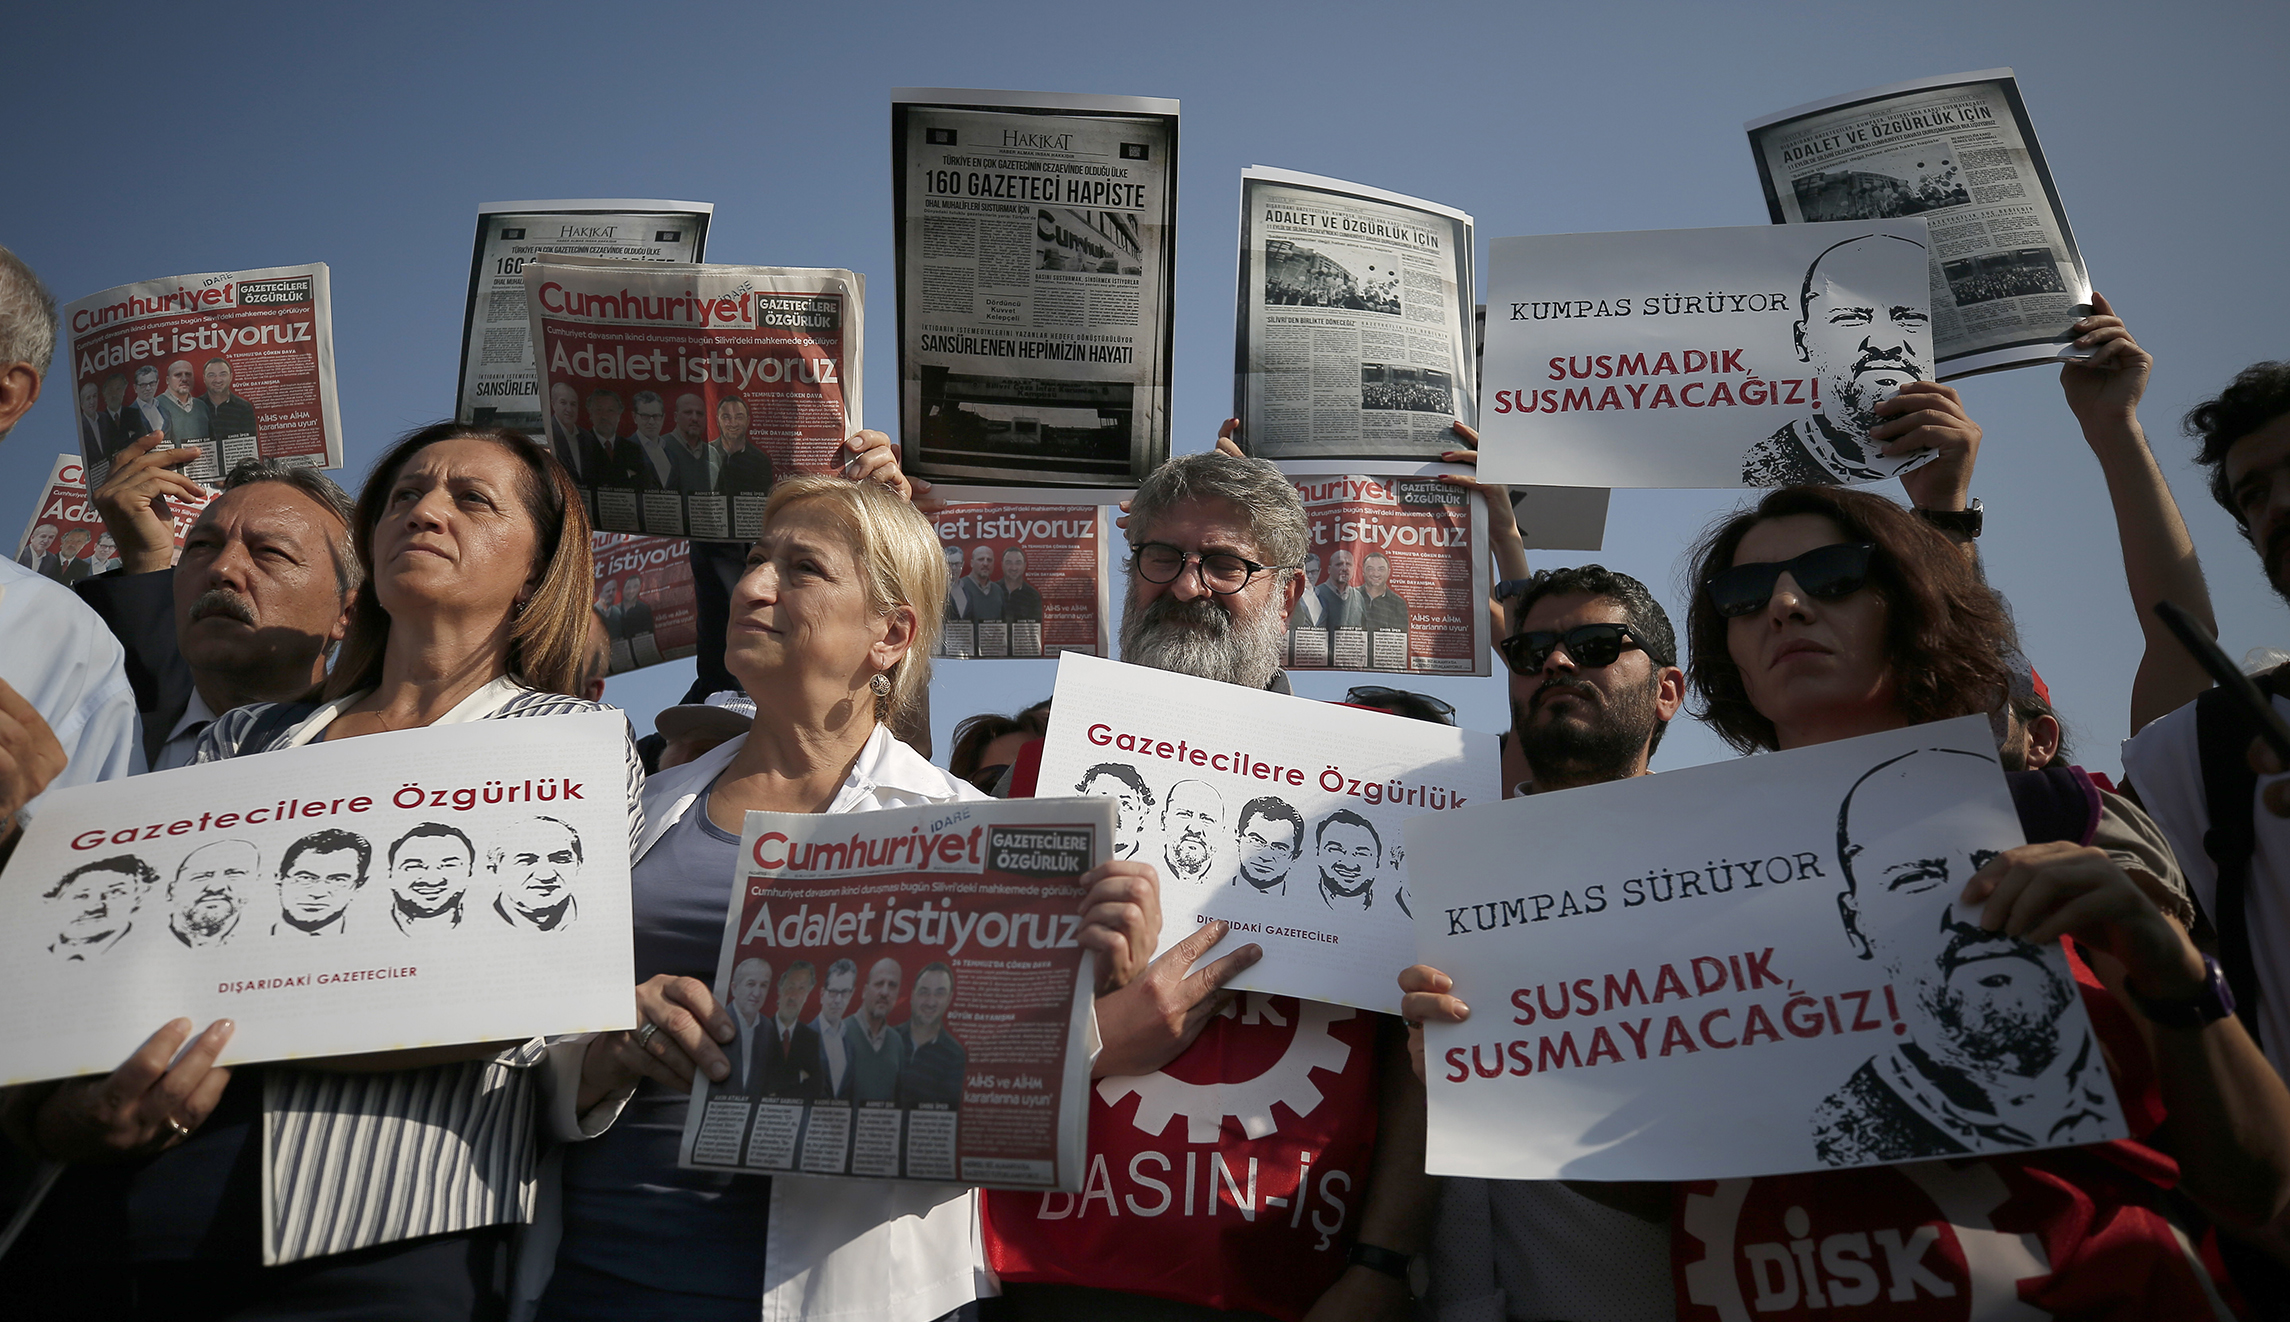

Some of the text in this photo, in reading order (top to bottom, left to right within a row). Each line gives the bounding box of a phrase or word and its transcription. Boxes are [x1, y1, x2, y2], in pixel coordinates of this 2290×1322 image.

[1002, 129, 1073, 150] HAKİKAT
[1784, 135, 1844, 164] ADALET
[1846, 129, 1867, 144] VE
[1872, 111, 1957, 138] ÖZGÜRLÜK
[1958, 104, 1992, 122] İÇİN
[942, 155, 1128, 178] TÜRKİYE EN ÇOK GAZETECİNİN CEZAEVİNDE OLDUĞU ÜLKE
[926, 169, 1146, 208] 160 GAZETECİ HAPİSTE
[942, 200, 980, 212] MUHALİFLERİ
[981, 202, 1016, 214] SUSTURMAK
[1017, 204, 1030, 215] İÇİN
[1266, 210, 1440, 248] ADALET VE ÖZGÜRLÜK İÇİN
[496, 258, 522, 274] 160
[240, 282, 308, 293] GAZETECİLERE
[245, 292, 304, 304] ÖZGÜRLÜK
[72, 282, 234, 334] Cumhuriyet
[538, 281, 752, 328] Cumhuriyet
[759, 298, 837, 313] GAZETECİLERE
[986, 298, 1022, 308] Dördüncü
[990, 306, 1016, 314] Kuvvet
[1510, 290, 1790, 322] KUMPAS SÜRÜYOR
[765, 312, 830, 328] ÖZGÜRLÜK
[986, 314, 1020, 322] Kelepçeli
[78, 321, 312, 380] Adalet istiyoruz
[546, 326, 838, 348] Cumhuriyet davasının ikinci duruşması bugün Silivri'deki mahkemede görülüyor
[921, 333, 1133, 364] SANSÜRLENEN HEPİMİZİN HAYATI
[550, 340, 668, 382] Adalet
[678, 346, 838, 391] istiyoruz
[1548, 348, 1754, 382] SUSMADIK,
[476, 380, 539, 396] SANSÜRLEN
[1494, 370, 1824, 416] SUSMAYACAĞIZ!
[1294, 476, 1394, 502] huriyet
[1400, 482, 1466, 494] GAZETECİLERE
[1404, 492, 1460, 505] ÖZGÜRLÜK
[1342, 507, 1364, 515] bugün
[1395, 510, 1434, 518] mahkemede
[1435, 510, 1466, 518] görülüyor
[976, 514, 1094, 543] istiyoruz
[1334, 516, 1468, 550] istiyoruz
[1086, 722, 1468, 810] Gazetecilere Özgürlük
[69, 778, 584, 852] Gazetecilere Özgürlük
[930, 806, 972, 833] İDARE
[752, 824, 983, 870] Cumhuriyet
[992, 831, 1087, 852] GAZETECİLERE
[997, 850, 1080, 872] ÖZGÜRLÜK
[750, 880, 1087, 900] Cumhuriyet davasının ikinci duruşması bugün Silivri'deki mahkemede görülüyo
[1445, 851, 1826, 936] KUMPAS SÜRÜYOR
[741, 896, 1082, 956] Adalet istiyoruz
[1265, 925, 1340, 946] GAZETECİLER
[218, 966, 418, 994] DIŞARIDAKİ GAZETECİLER
[1511, 947, 1794, 1027] SUSMADIK,
[1444, 983, 1908, 1084] SUSMAYACAĞIZ!
[1744, 1204, 1956, 1313] DİSK
